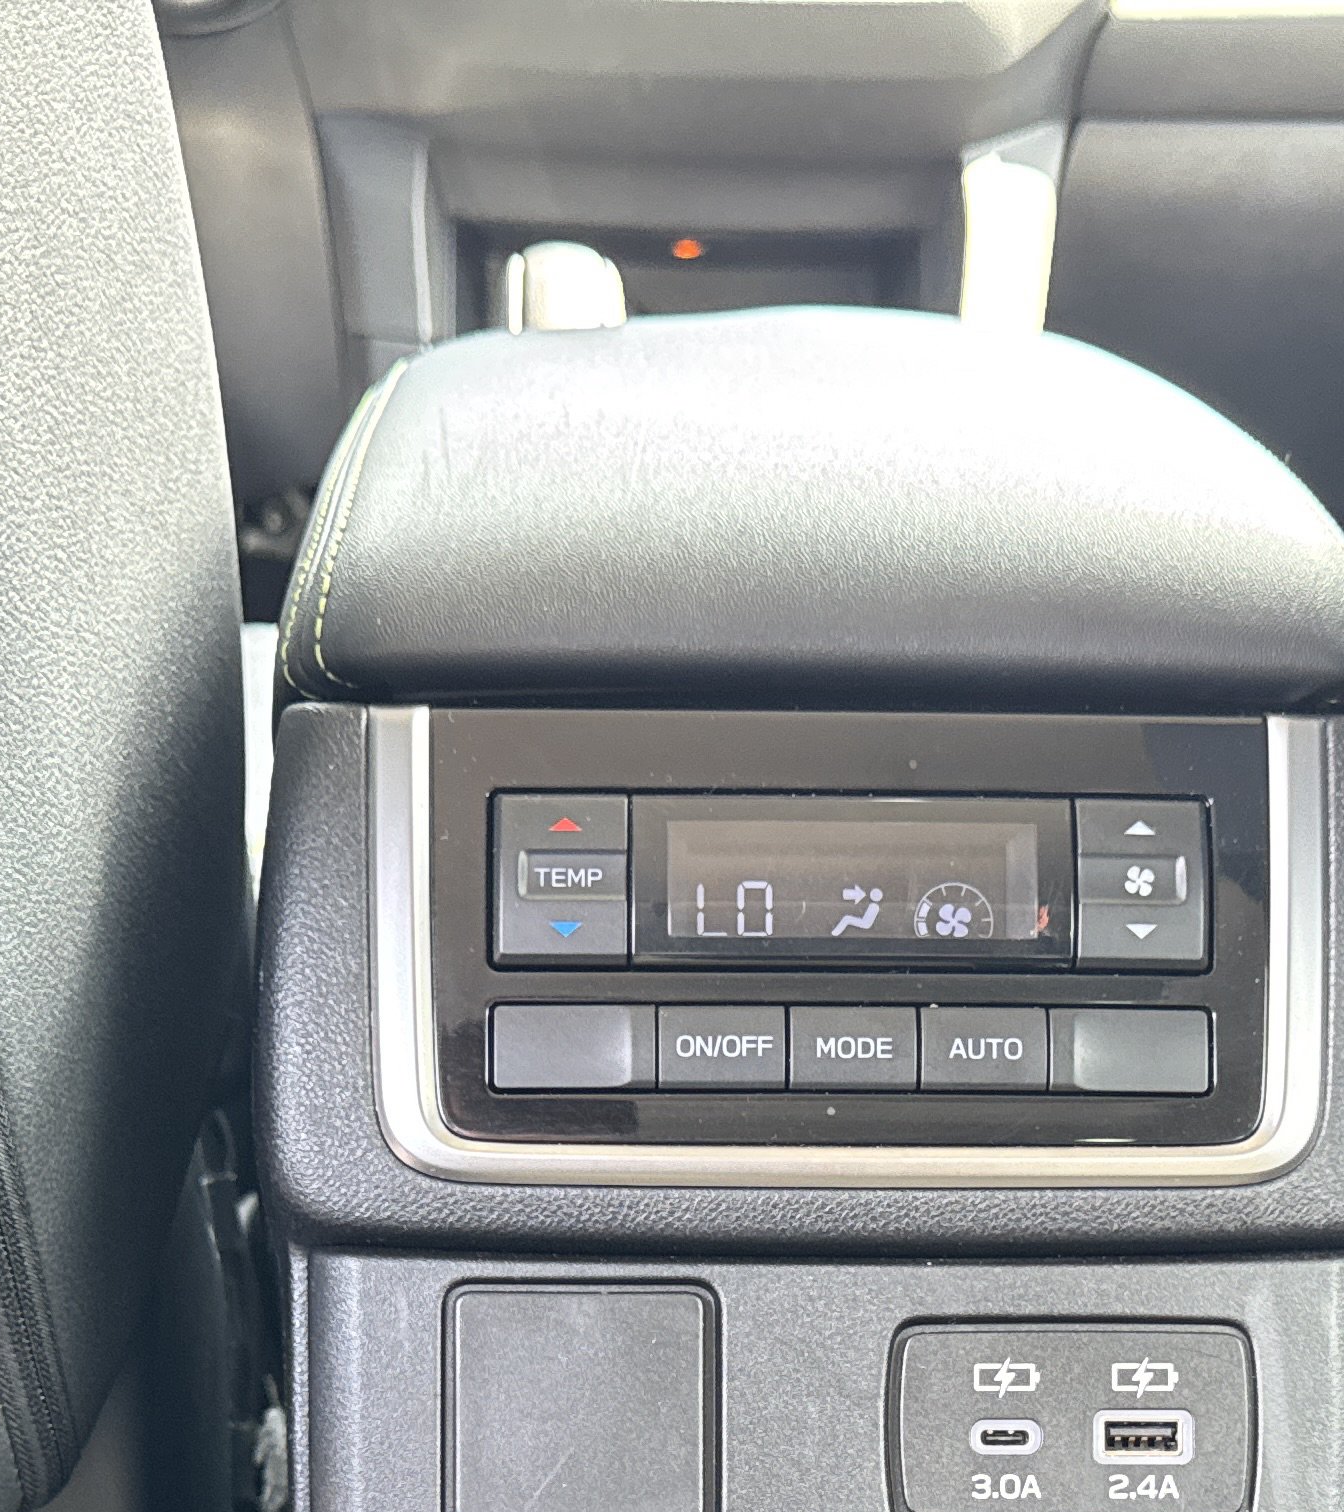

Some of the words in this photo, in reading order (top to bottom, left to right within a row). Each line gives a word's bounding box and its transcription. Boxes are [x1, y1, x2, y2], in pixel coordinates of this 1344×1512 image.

[534, 867, 604, 888] TEMP
[675, 1035, 774, 1060] ON/OFF
[816, 1037, 894, 1060] MODE
[949, 1037, 1024, 1061] AUTO
[971, 1474, 1042, 1500] 3.0A
[1108, 1474, 1180, 1501] 2.4A
